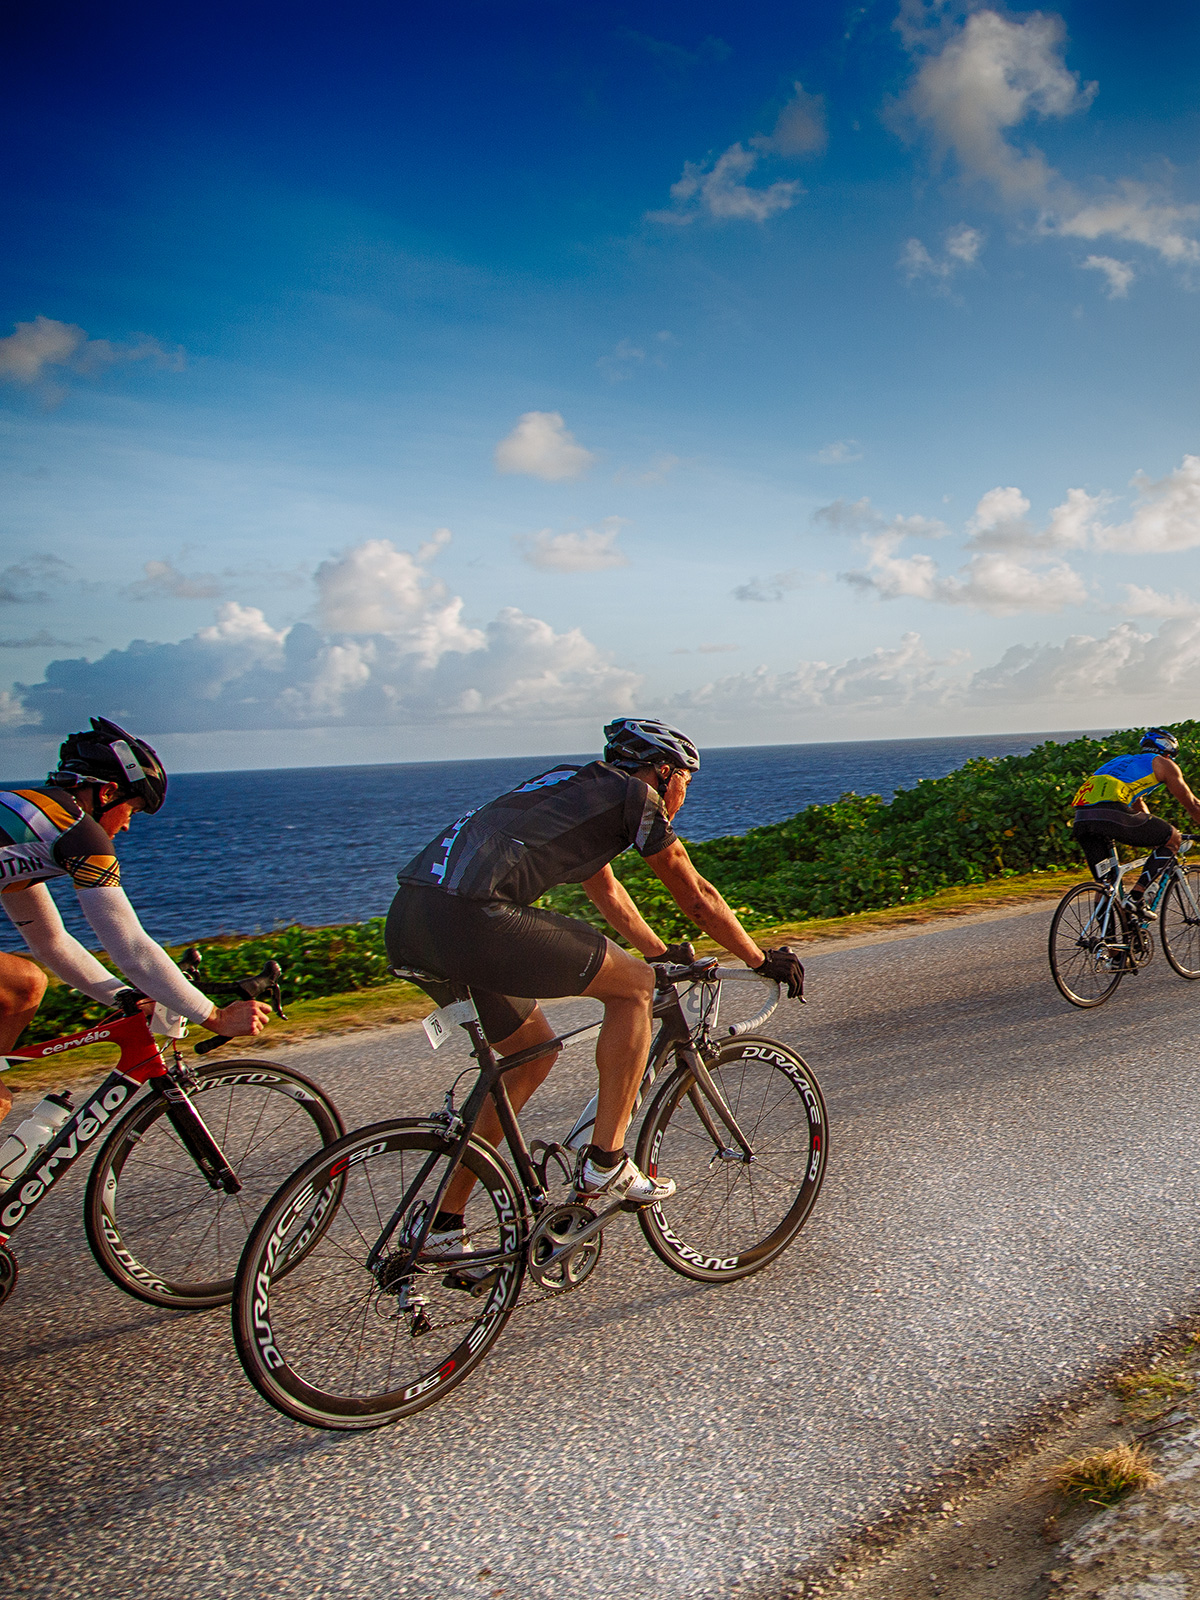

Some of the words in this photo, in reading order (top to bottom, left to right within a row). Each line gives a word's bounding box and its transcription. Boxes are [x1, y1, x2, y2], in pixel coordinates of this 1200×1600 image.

[42, 1030, 111, 1055] cervélo
[741, 1046, 821, 1125] DURA-ACE
[1, 1085, 128, 1227] cervélo
[330, 1141, 388, 1177] C50
[253, 1182, 315, 1369] DURA-ACE
[403, 1360, 456, 1401] C50
